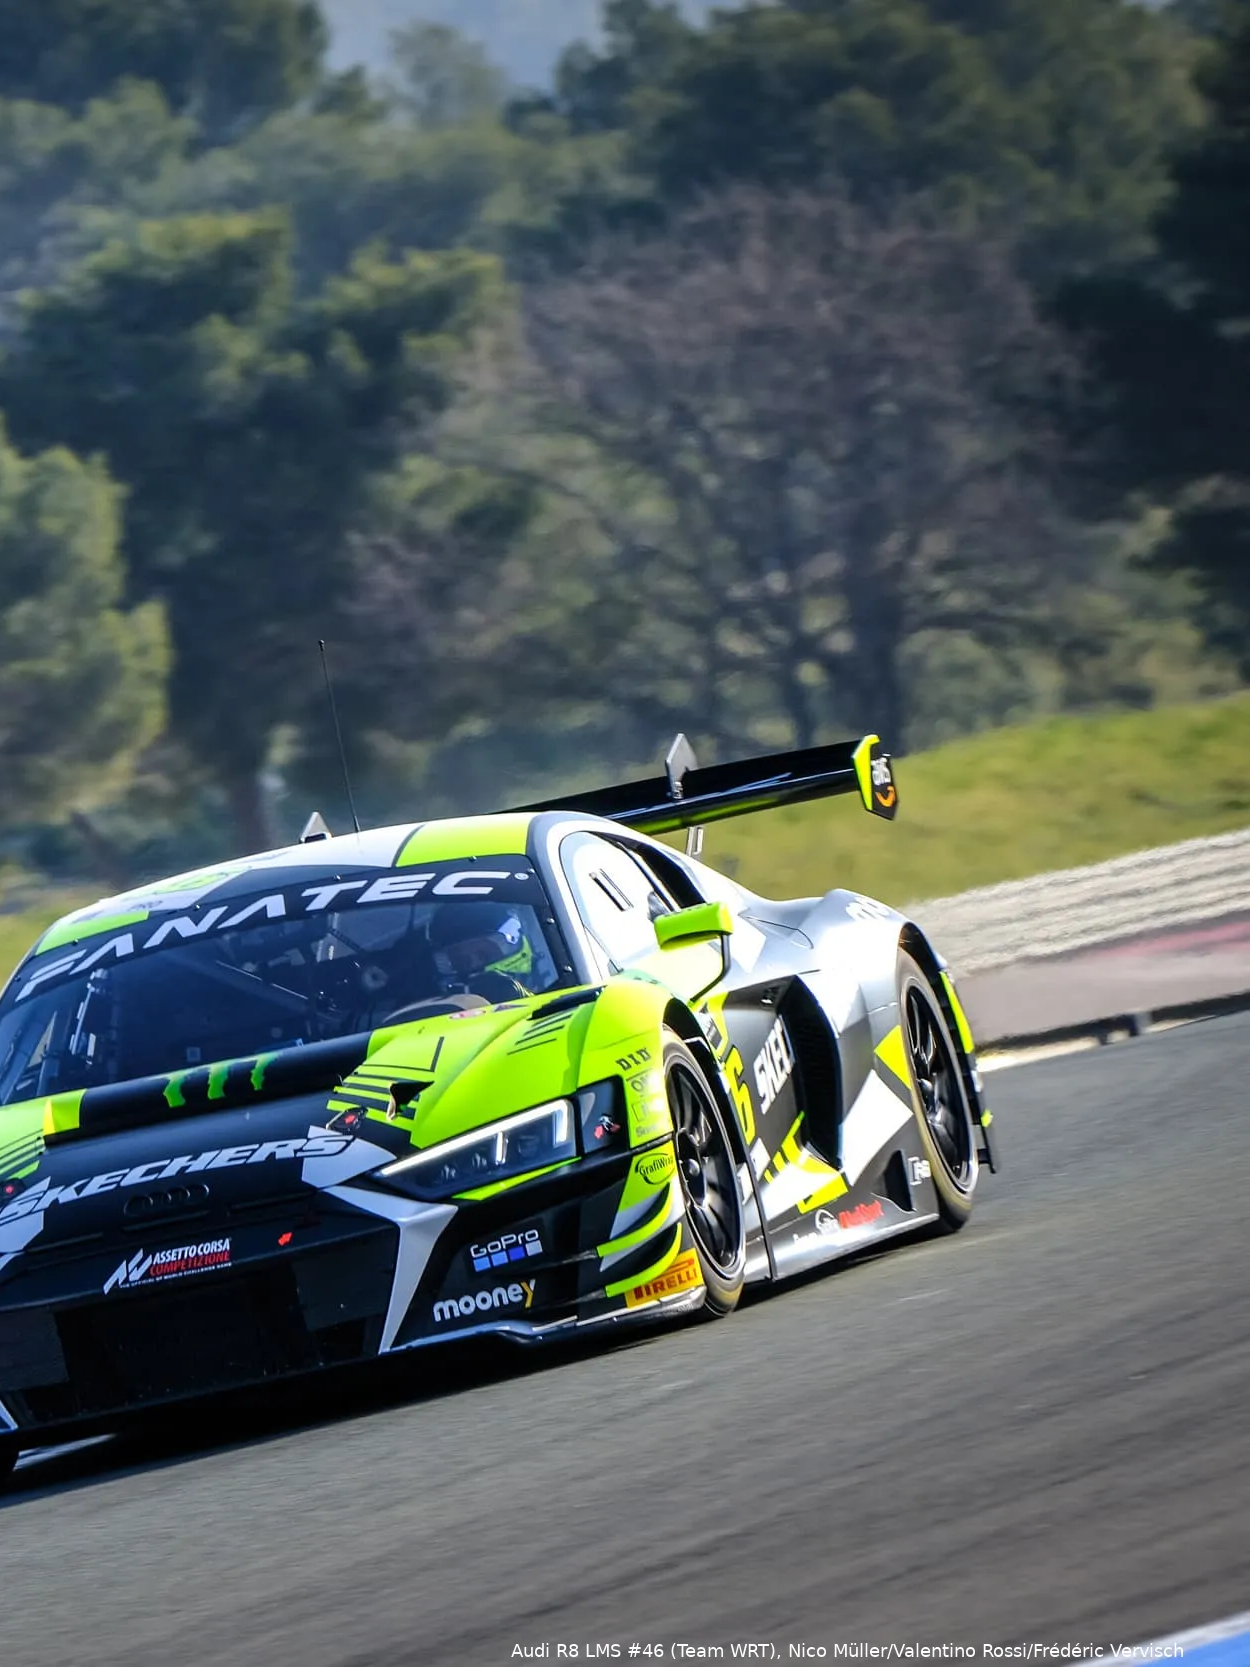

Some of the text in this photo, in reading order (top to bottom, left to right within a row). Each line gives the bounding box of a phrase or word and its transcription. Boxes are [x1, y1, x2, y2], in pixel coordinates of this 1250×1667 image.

[15, 870, 512, 1001] FANATEC
[153, 1237, 230, 1265] ASSETTO CORSA
[470, 1228, 540, 1259] GoPro
[150, 1251, 231, 1276] COMPETIZIONE
[633, 1266, 698, 1300] PIRELLI
[432, 1279, 537, 1322] mooney
